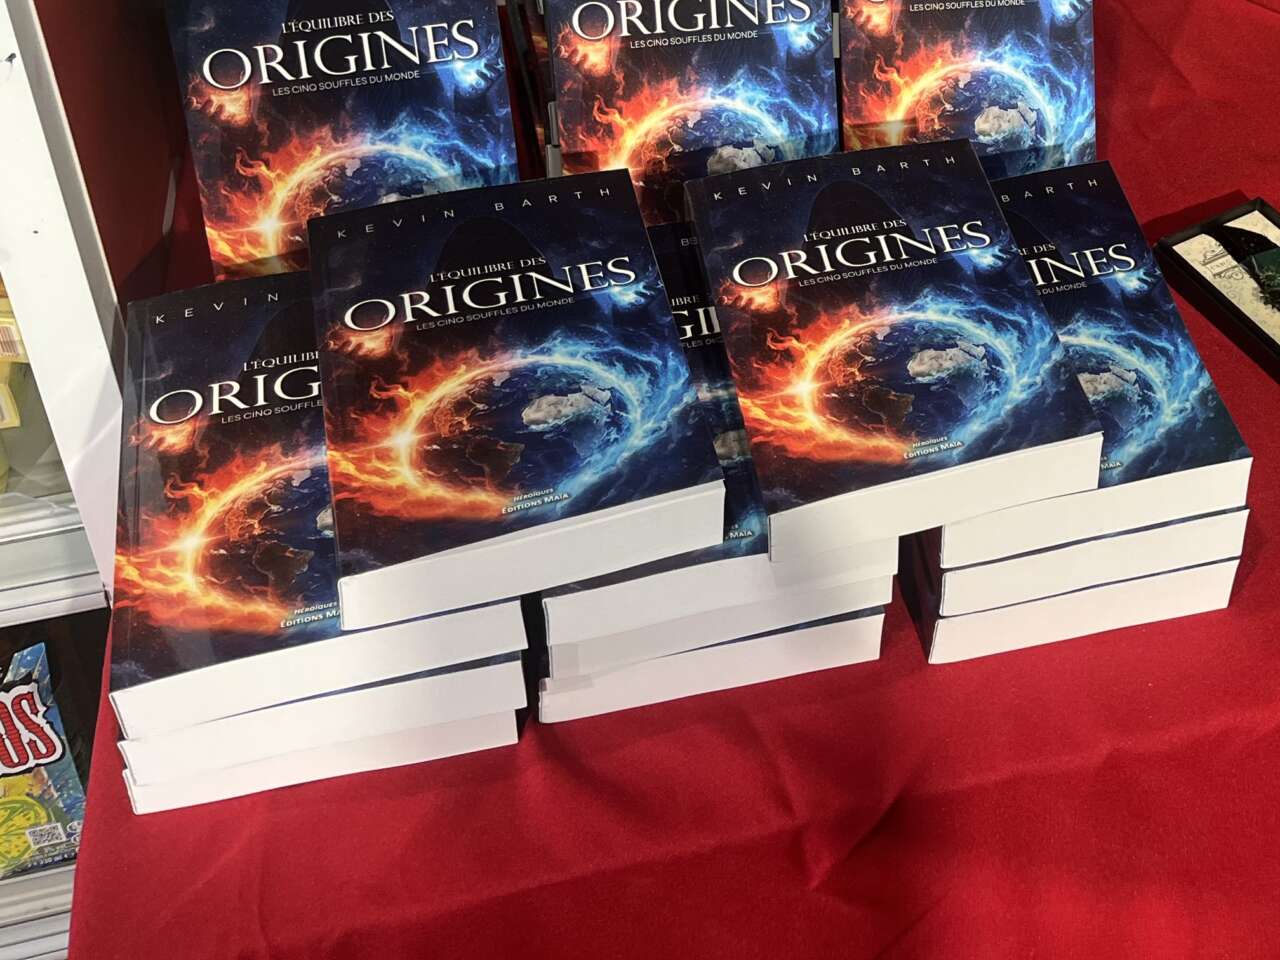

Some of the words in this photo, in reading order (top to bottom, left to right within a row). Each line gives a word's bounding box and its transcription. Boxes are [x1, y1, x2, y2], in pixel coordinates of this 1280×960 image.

[368, 10, 394, 23] DES
[909, 4, 924, 12] LES
[924, 2, 945, 11] CINQ
[945, 0, 984, 10] SOUFFLES
[985, 0, 997, 7] DU
[630, 40, 645, 49] LES
[646, 38, 669, 48] CINQ
[669, 35, 713, 46] SOUFFLES
[714, 32, 727, 41] DU
[727, 29, 758, 40] MONDE
[202, 19, 479, 90] ORIGINES
[272, 86, 291, 97] LES
[291, 82, 317, 94] CINQ
[318, 77, 367, 91] SOUFFLES
[369, 74, 384, 85] DU
[385, 69, 420, 83] MONDE
[713, 174, 818, 201] KEVIN
[852, 156, 957, 176] BARTH
[1001, 178, 1098, 203] BARTH
[337, 209, 454, 239] KEVIN
[495, 187, 611, 211] BARTH
[883, 218, 907, 229] DES
[732, 220, 991, 288] ORIGINES
[1033, 242, 1056, 254] DES
[520, 256, 546, 268] DES
[799, 278, 815, 287] LES
[816, 273, 841, 285] CINQ
[842, 266, 888, 281] SOUFFLES
[890, 262, 903, 271] DU
[903, 256, 938, 269] MONDE
[344, 256, 636, 332] ORIGINES
[1056, 281, 1088, 293] MONDE
[155, 292, 279, 324] KEVIN
[416, 321, 434, 331] LES
[436, 315, 465, 328] CINQ
[466, 307, 519, 324] SOUFFLES
[520, 303, 535, 313] DU
[536, 296, 575, 310] MONDE
[221, 414, 242, 424] LES
[243, 408, 273, 420] CINQ
